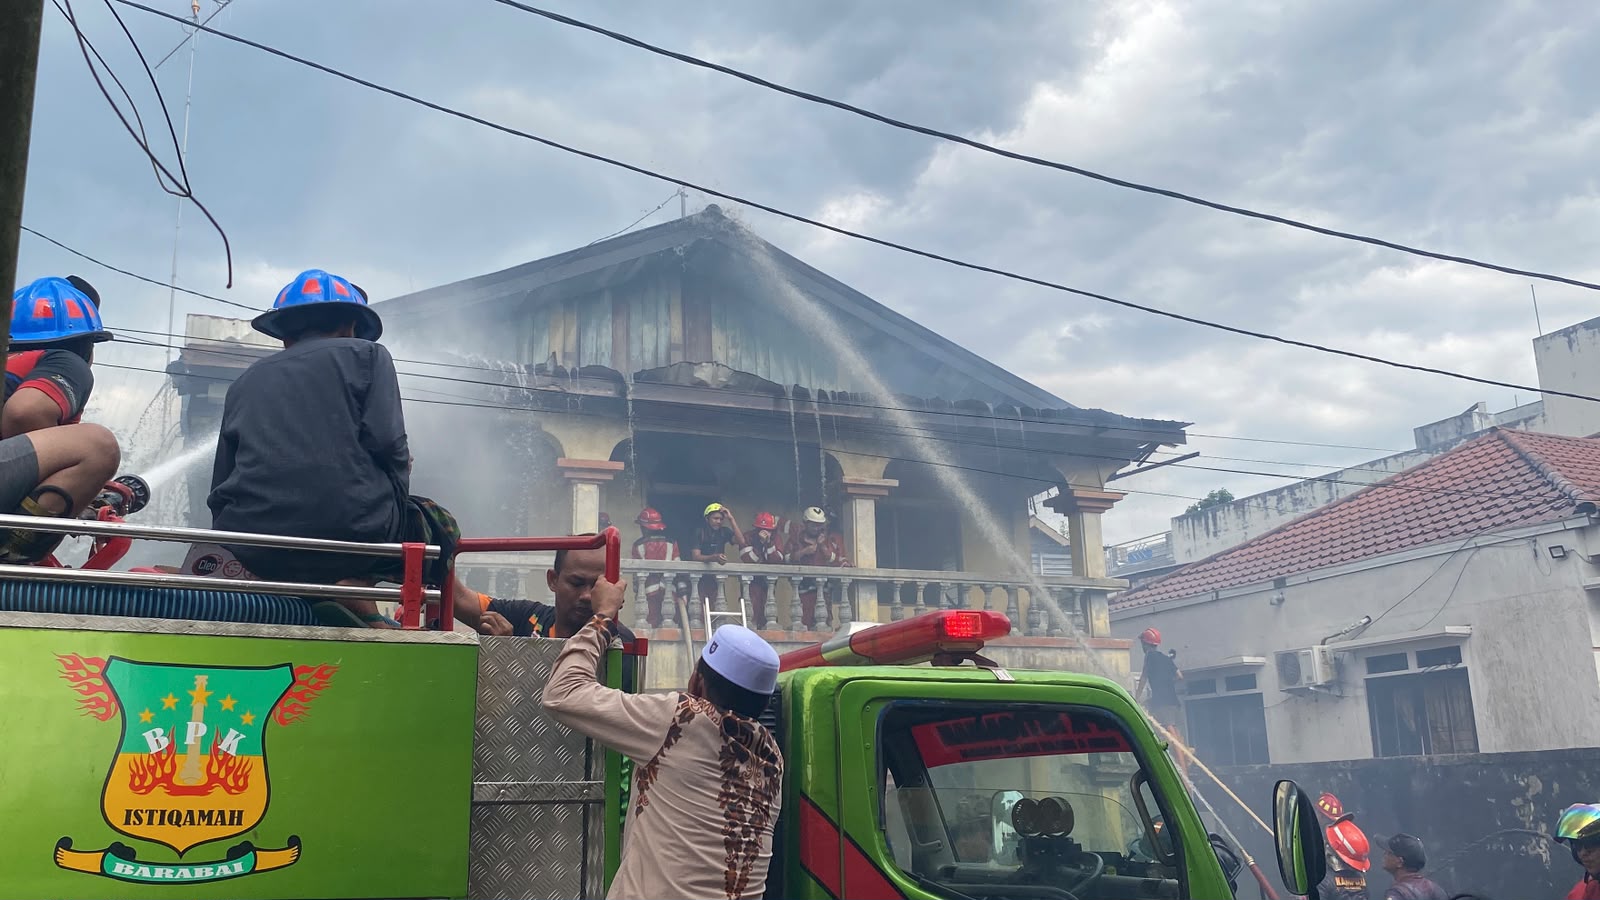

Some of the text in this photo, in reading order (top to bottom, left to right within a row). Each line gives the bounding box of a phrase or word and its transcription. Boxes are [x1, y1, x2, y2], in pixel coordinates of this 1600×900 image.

[198, 560, 217, 571] Cleo
[142, 721, 246, 756] BPK
[123, 809, 244, 827] ISTIQAMAH
[112, 862, 244, 878] BARABAI
